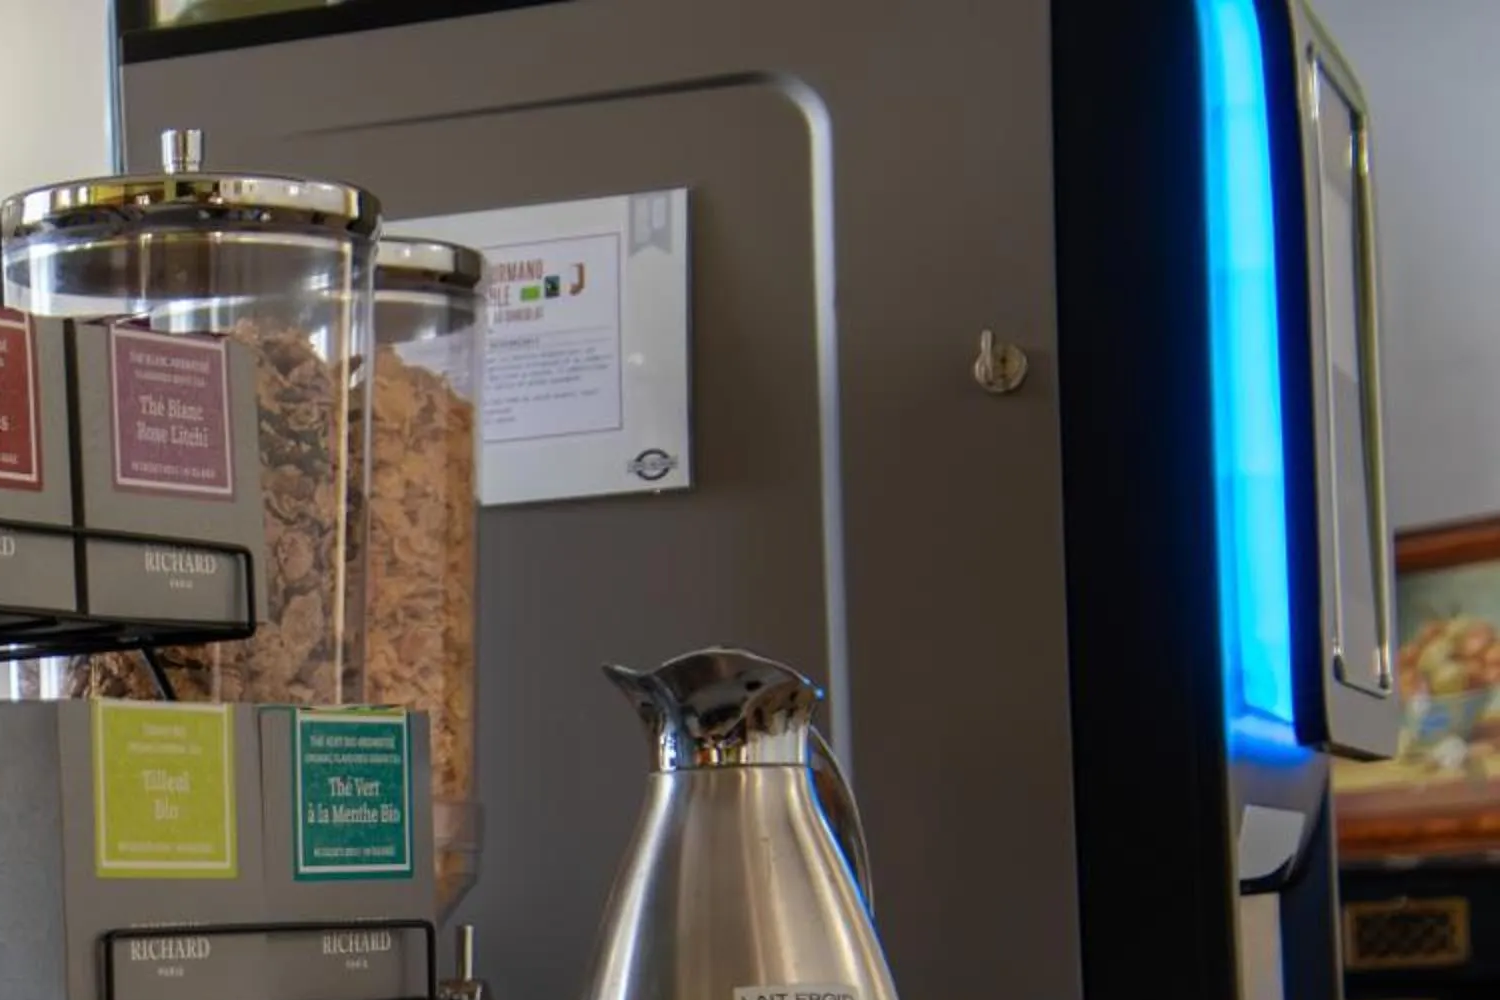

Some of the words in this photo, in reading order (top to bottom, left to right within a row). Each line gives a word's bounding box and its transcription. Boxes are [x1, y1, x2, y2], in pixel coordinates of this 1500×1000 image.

[144, 550, 217, 574] RICHARD
[328, 776, 353, 797] Thé
[354, 777, 381, 797] Vert
[318, 803, 329, 823] la
[332, 802, 379, 823] Menthe
[130, 937, 210, 961] RICHARD
[322, 931, 391, 955] RICHARD
